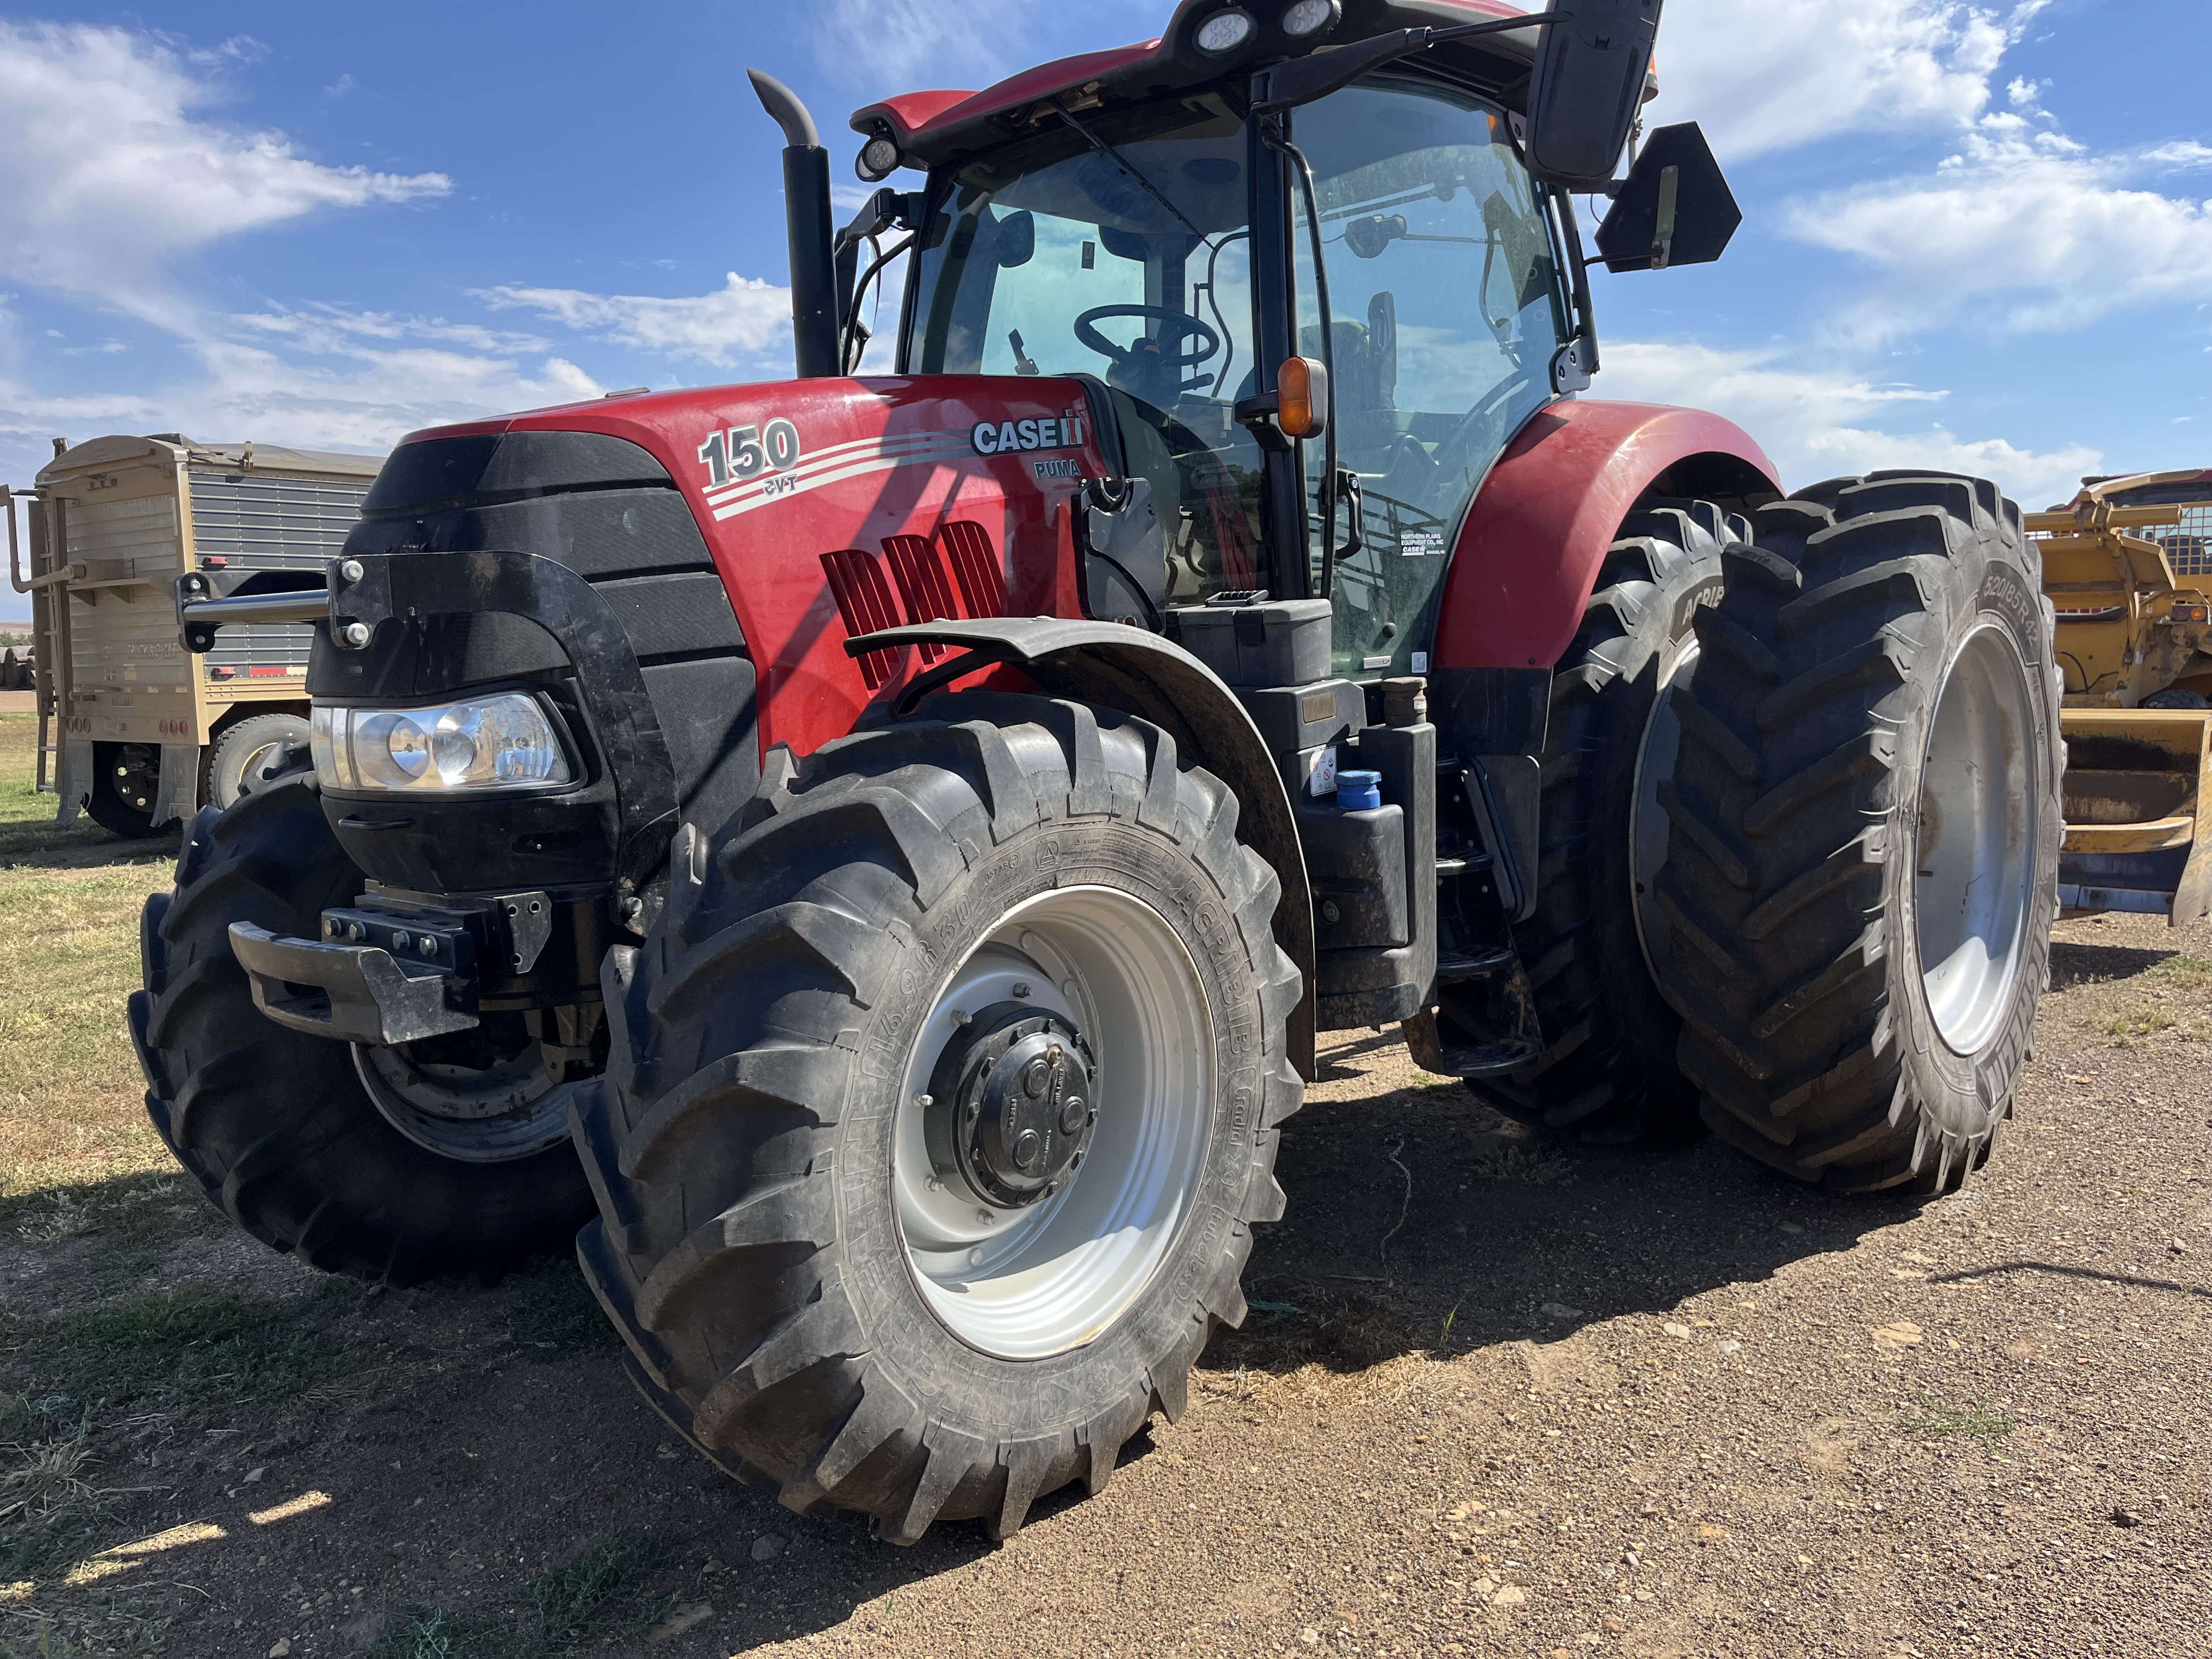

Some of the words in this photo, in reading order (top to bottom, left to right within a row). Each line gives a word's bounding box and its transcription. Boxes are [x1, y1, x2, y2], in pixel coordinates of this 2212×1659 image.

[697, 417, 800, 488] 150
[974, 419, 1058, 454] CASE
[1034, 459, 1081, 479] PUMA
[763, 474, 797, 495] CVT
[1984, 576, 2022, 610] 520/85
[2017, 601, 2029, 624] R
[2025, 620, 2038, 648] 42
[869, 968, 918, 1053] 16.9
[915, 940, 938, 974] R
[933, 893, 973, 950] 30
[1171, 879, 1252, 1054] AGRIBIB
[1987, 889, 2052, 1106] MICHELIN
[1229, 1094, 1249, 1147] radial
